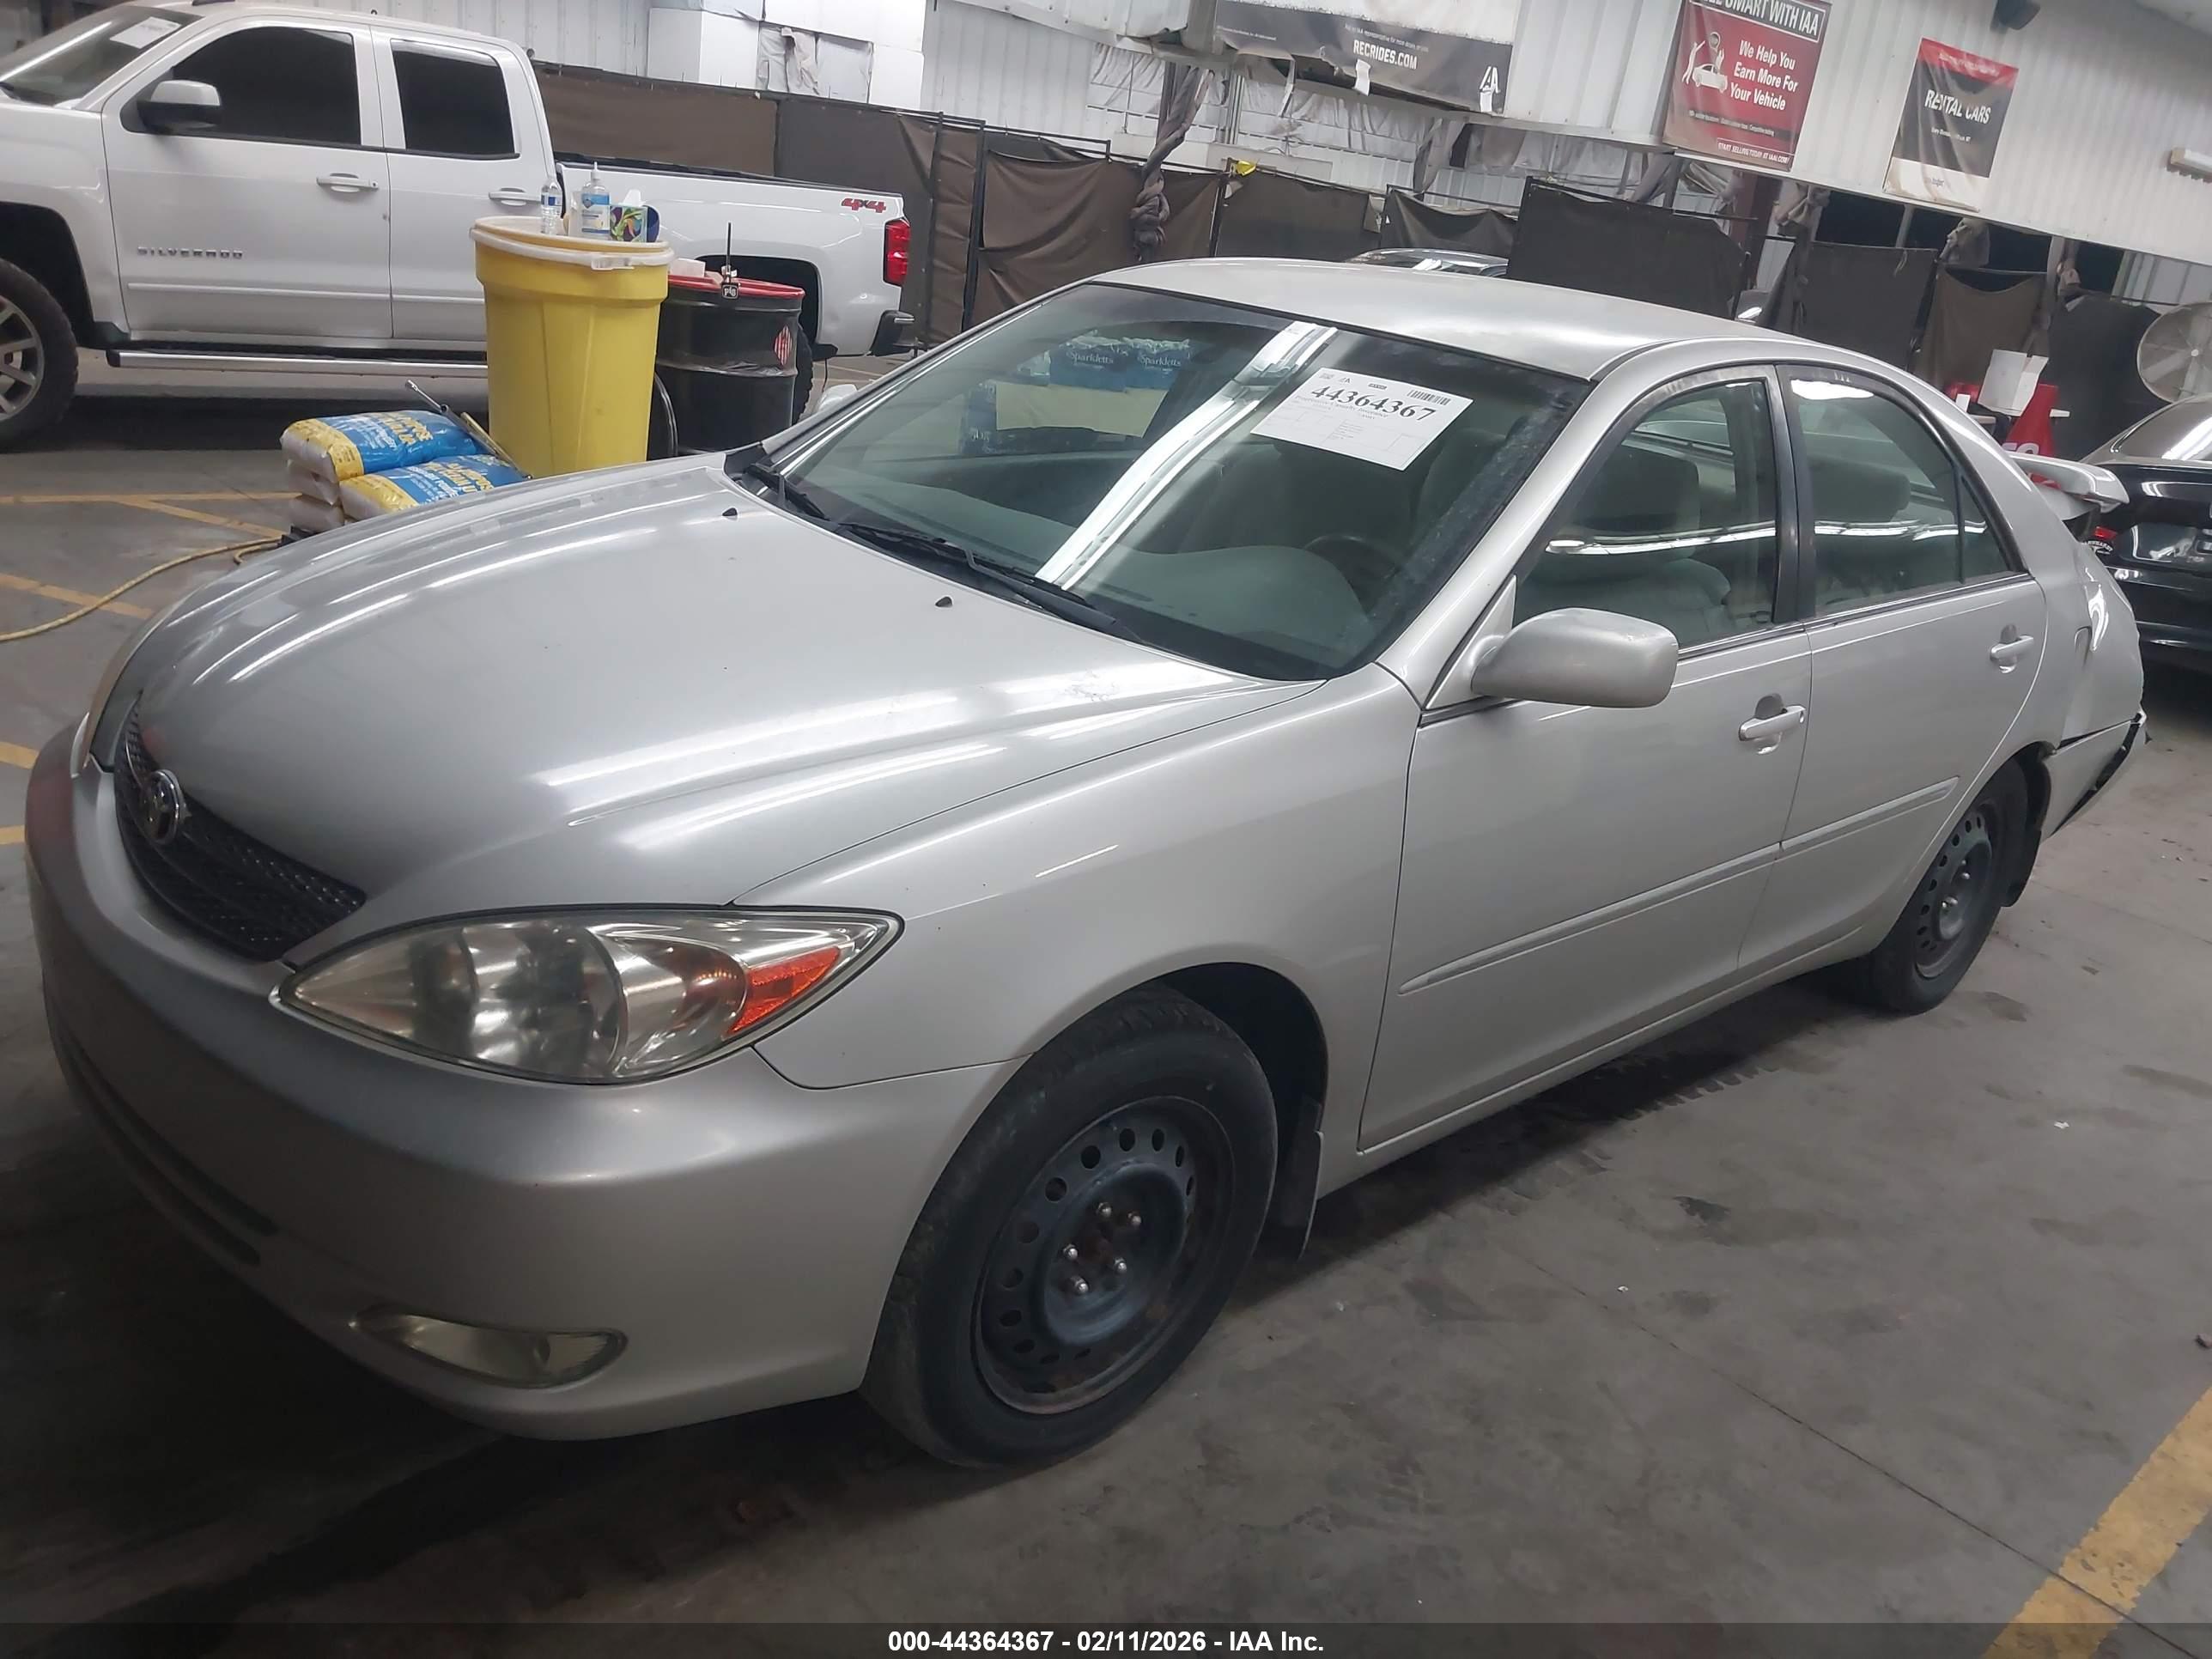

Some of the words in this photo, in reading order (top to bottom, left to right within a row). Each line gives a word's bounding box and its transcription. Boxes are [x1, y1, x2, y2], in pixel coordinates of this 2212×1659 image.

[1770, 0, 1800, 27] WITH
[1799, 8, 1820, 36] IAA
[1353, 40, 1417, 70] RECRIDES.COM
[1739, 40, 1753, 58] We
[1756, 46, 1777, 66] Help
[1778, 52, 1796, 70] You
[1734, 62, 1755, 82] Earn
[1758, 68, 1781, 88] More
[1782, 76, 1798, 92] For
[1729, 82, 1751, 103] Your
[1753, 88, 1786, 111] Vehicle
[1924, 89, 1963, 118] RENTAL
[1965, 106, 1992, 124] CARS
[137, 246, 243, 258] SILVERADO
[1070, 349, 1114, 366] Sparkletts
[1139, 354, 1182, 367] Sparkletts
[1311, 386, 1437, 422] 44364367
